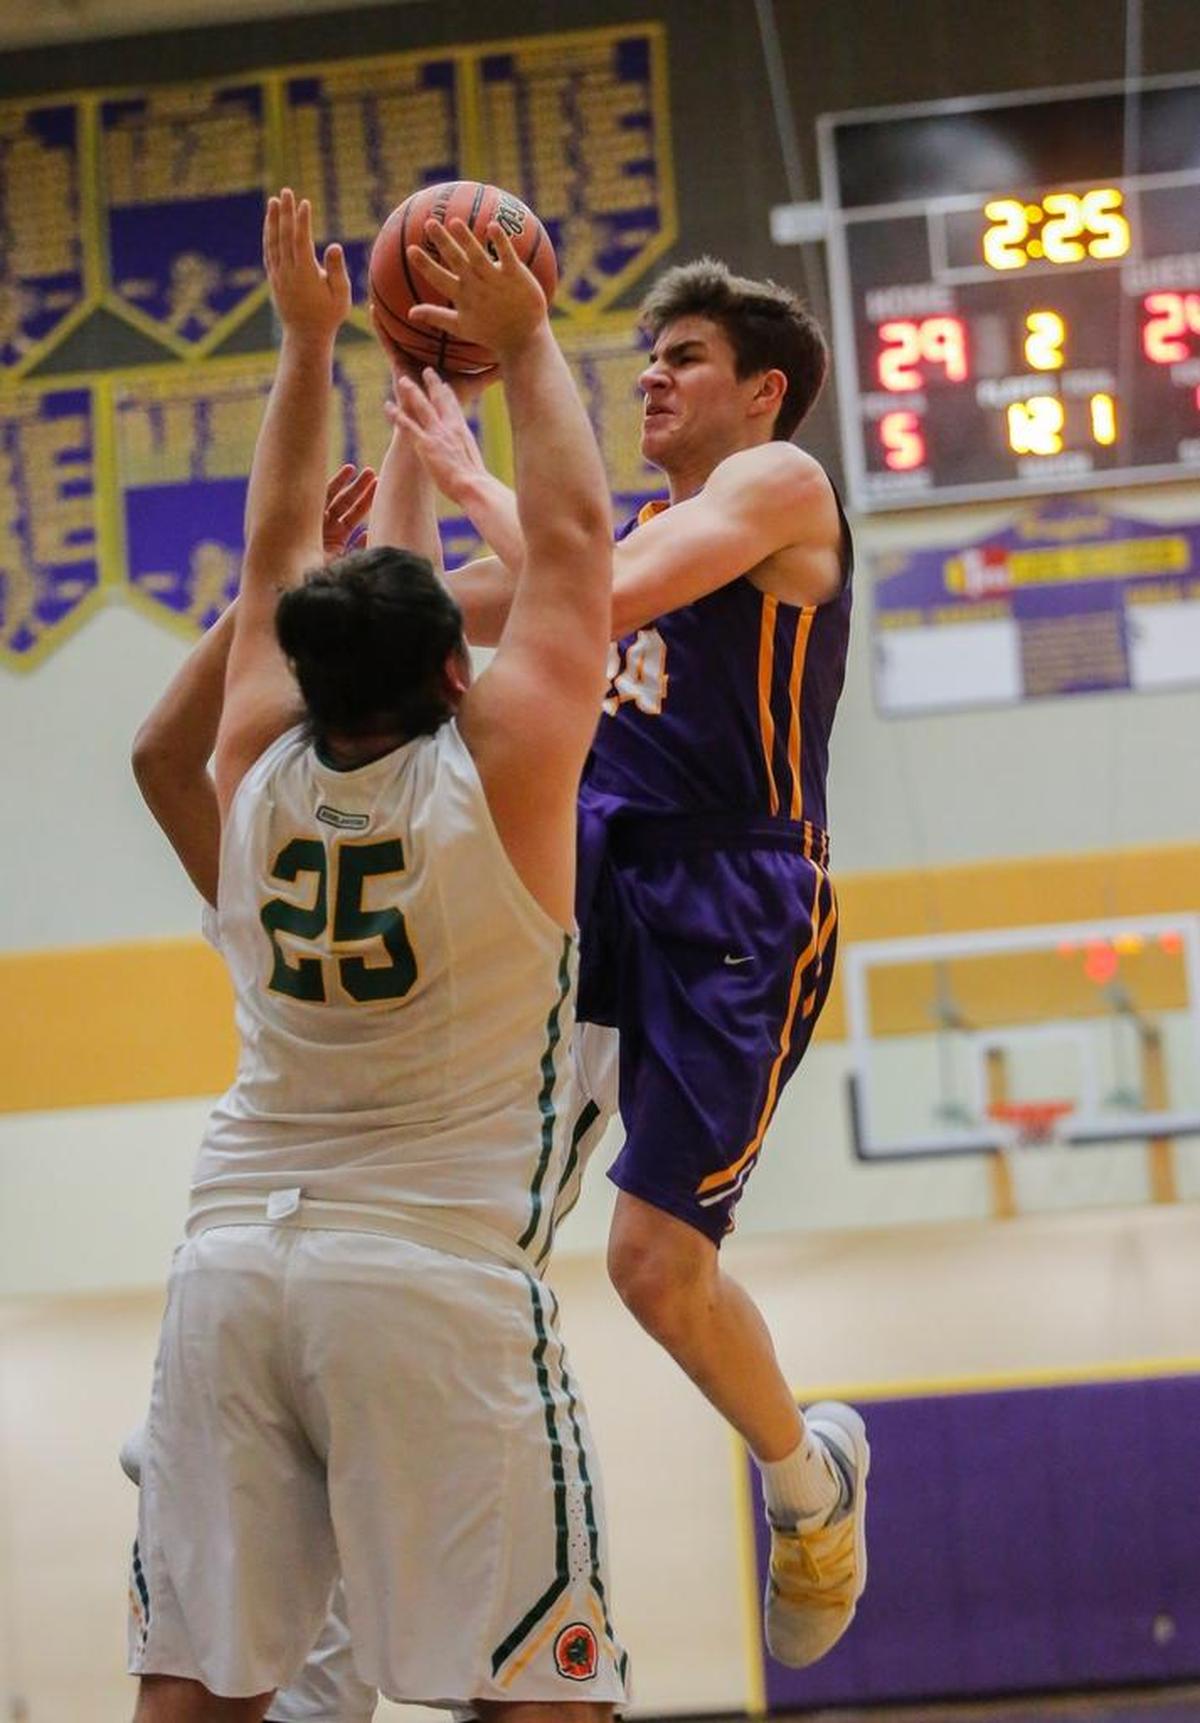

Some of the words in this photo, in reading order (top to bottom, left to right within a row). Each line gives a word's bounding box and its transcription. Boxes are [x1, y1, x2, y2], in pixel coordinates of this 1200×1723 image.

[982, 188, 1130, 270] 2:25
[877, 316, 968, 392] 29
[1024, 310, 1064, 370] 2
[879, 410, 925, 471] 5
[260, 837, 418, 1003] 25
